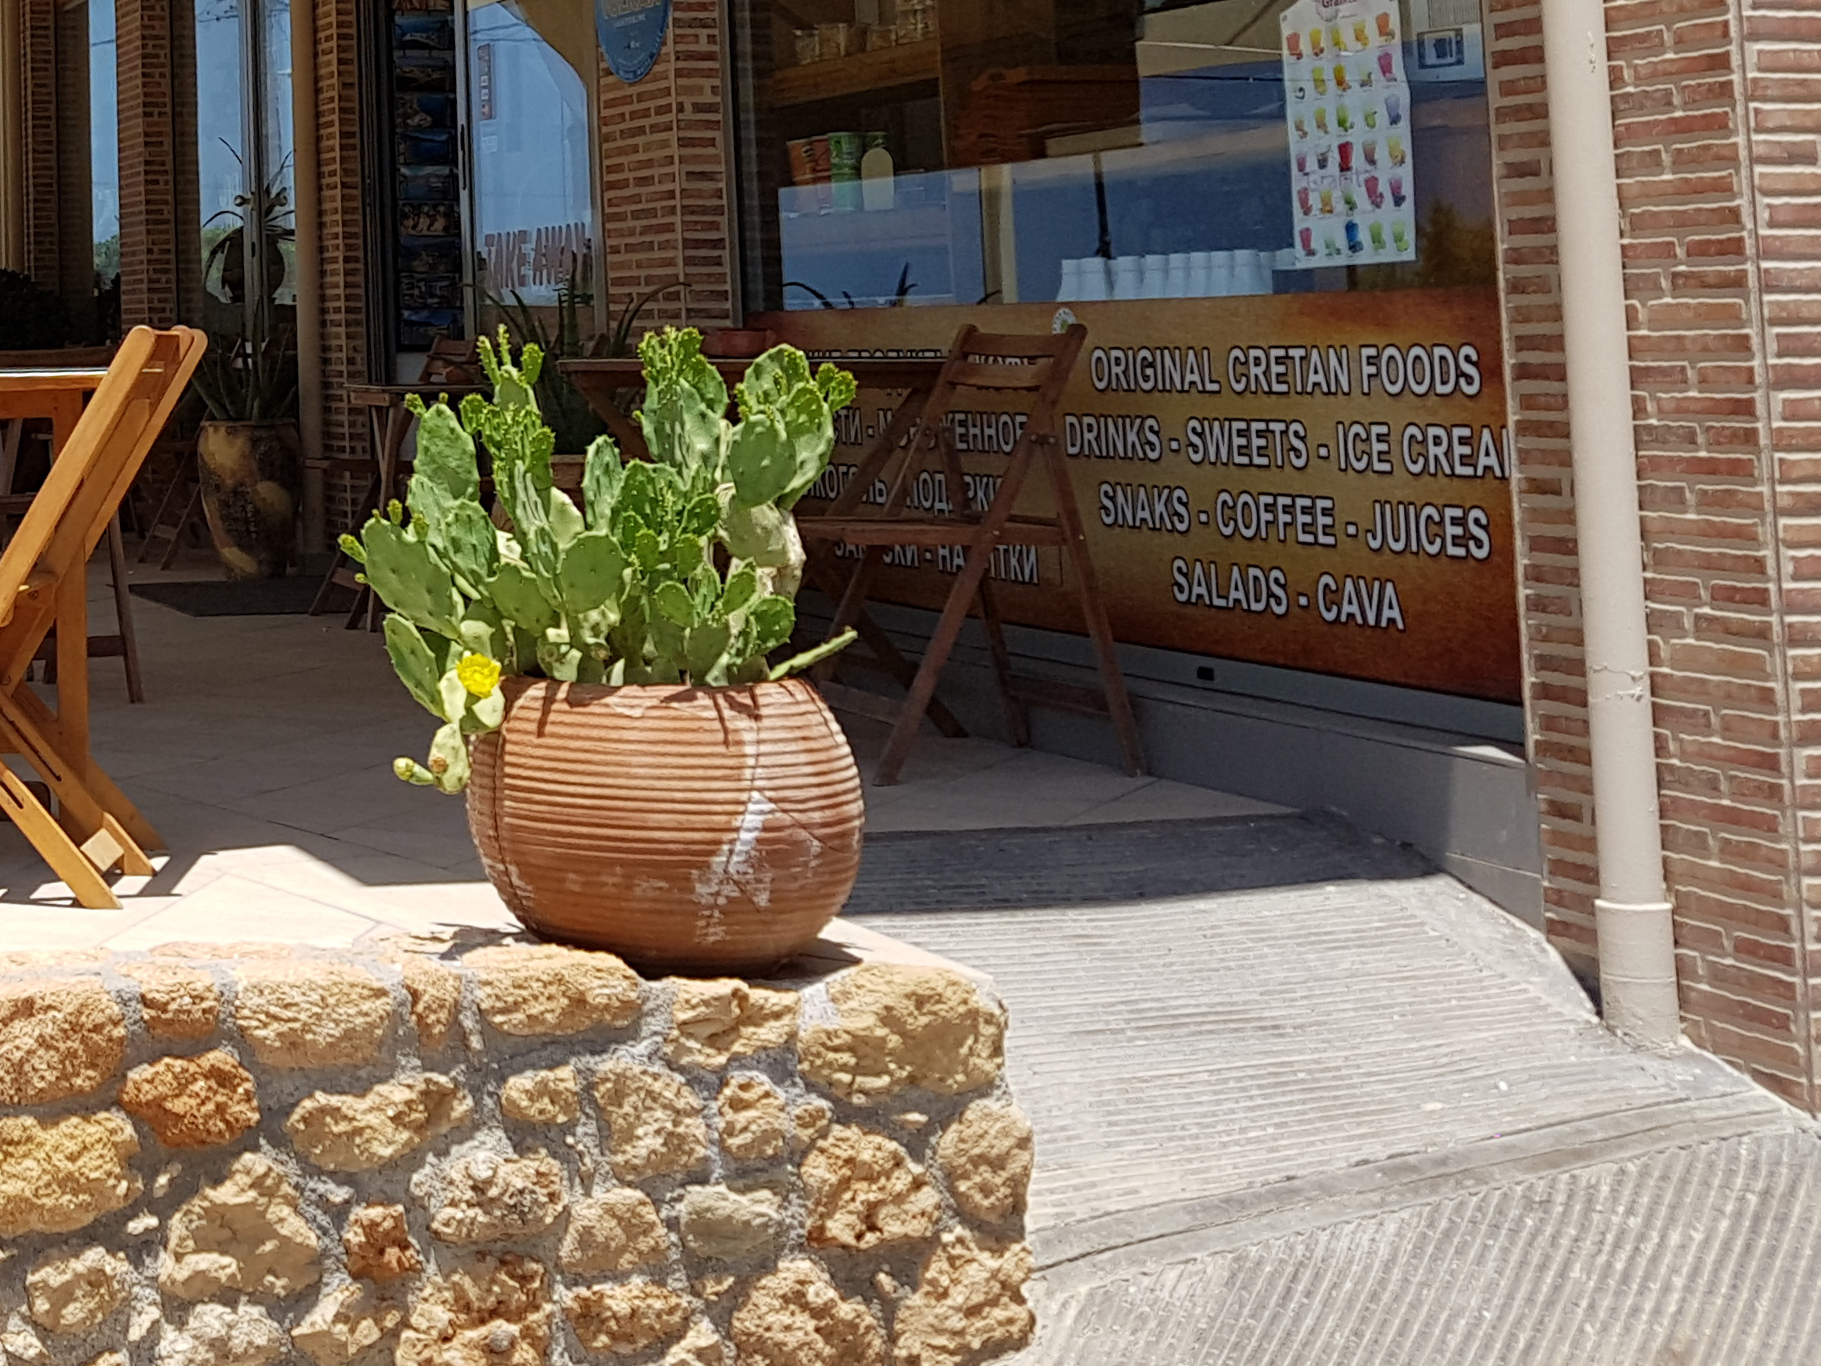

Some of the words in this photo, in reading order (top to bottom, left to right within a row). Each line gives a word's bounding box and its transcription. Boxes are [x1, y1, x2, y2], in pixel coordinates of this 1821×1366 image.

[485, 230, 527, 289] TAKE
[1090, 348, 1220, 395] ORIGINAL
[1228, 346, 1350, 395] CRETAN
[1360, 344, 1481, 398] FOODS
[1066, 414, 1161, 461] DRINKS
[1186, 420, 1308, 469] SWEETS
[1336, 423, 1391, 474] ICE
[1099, 482, 1189, 532] SNAKS
[1216, 492, 1337, 548] COFFEE
[1366, 500, 1492, 561] JUICES
[1172, 558, 1288, 616] SALADS
[1316, 574, 1404, 631] CAVA
